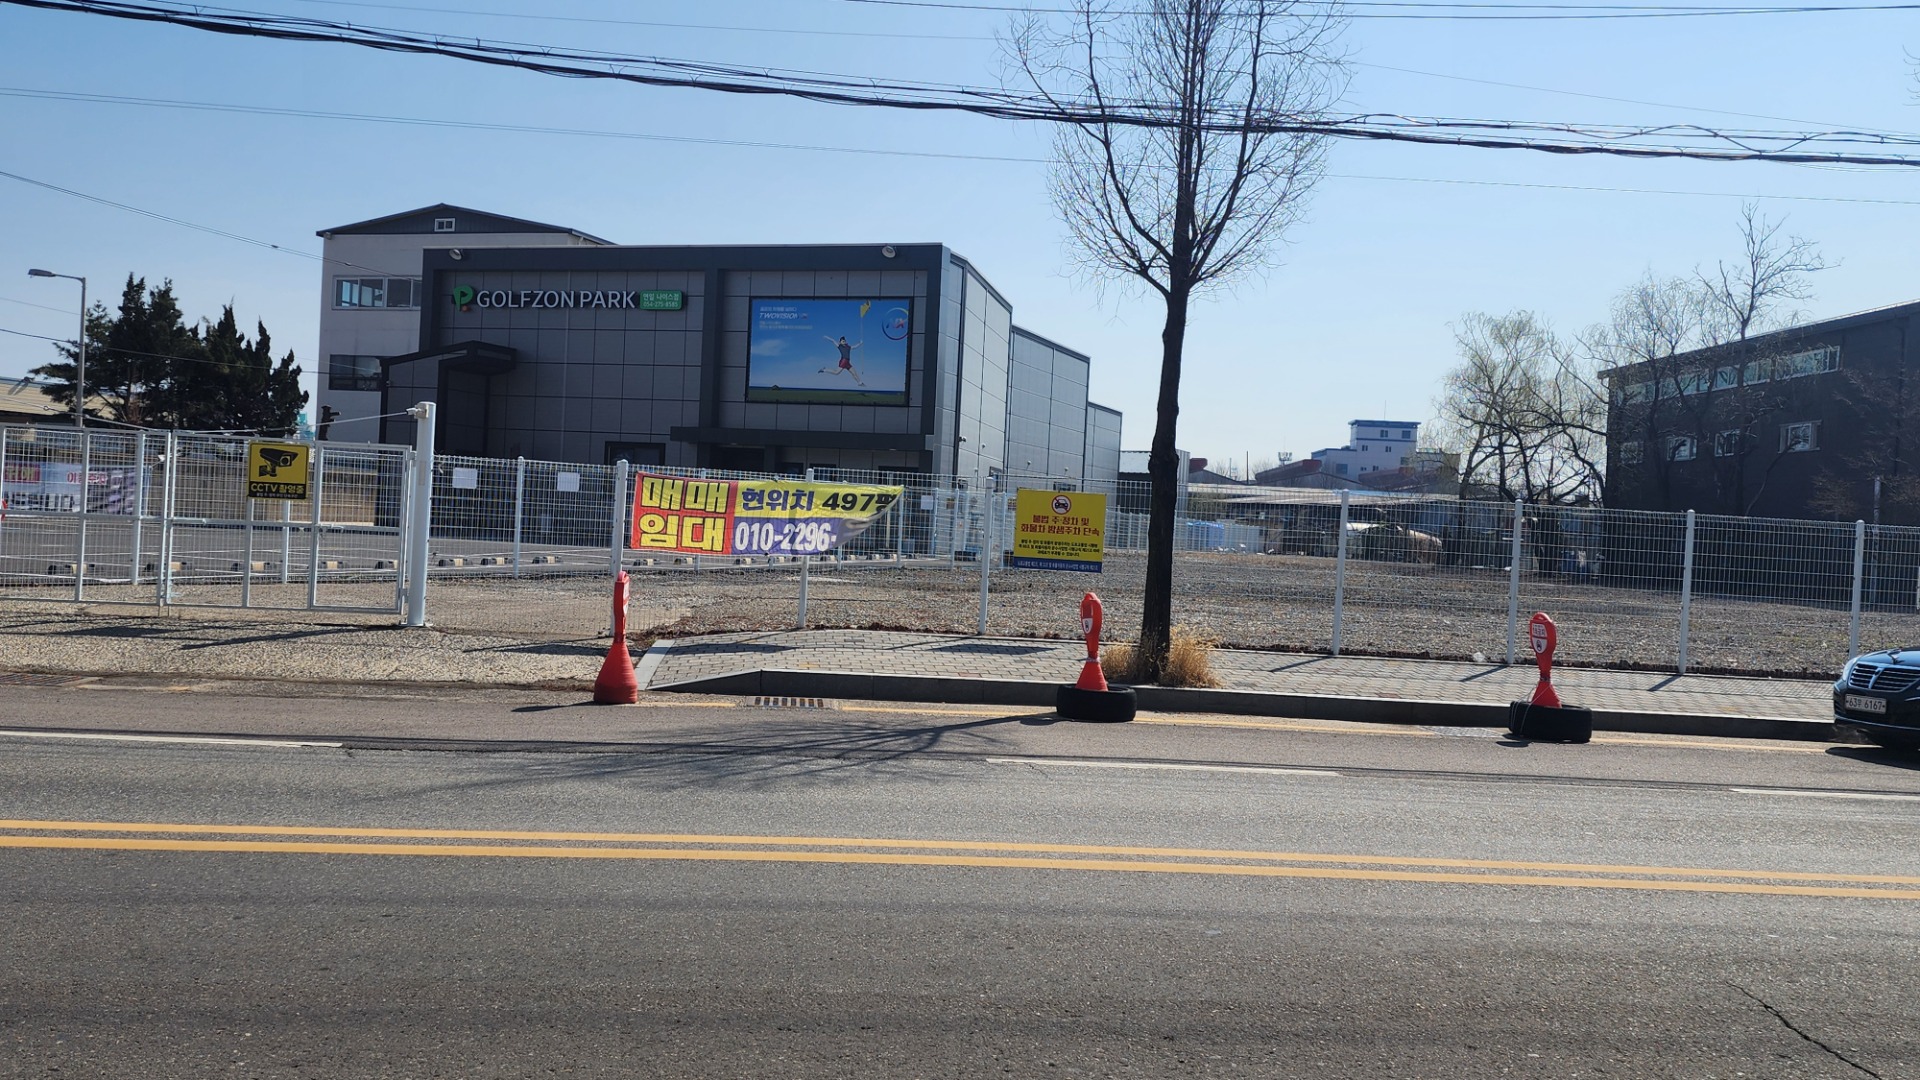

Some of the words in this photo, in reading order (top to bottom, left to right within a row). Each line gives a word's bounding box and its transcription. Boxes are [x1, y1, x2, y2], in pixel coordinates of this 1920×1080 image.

[476, 290, 575, 309] GOLFZON
[580, 290, 636, 309] PARK
[250, 483, 278, 492] CCTV
[641, 475, 730, 514] 매매
[741, 487, 814, 511] 현위치
[1033, 515, 1049, 524] 불법
[1081, 517, 1089, 526] 및
[638, 514, 726, 552] 임대
[1021, 523, 1045, 533] 화물차
[1048, 525, 1081, 535] 밤샘주차
[1083, 527, 1100, 537] 단속
[1864, 700, 1882, 710] 6167
